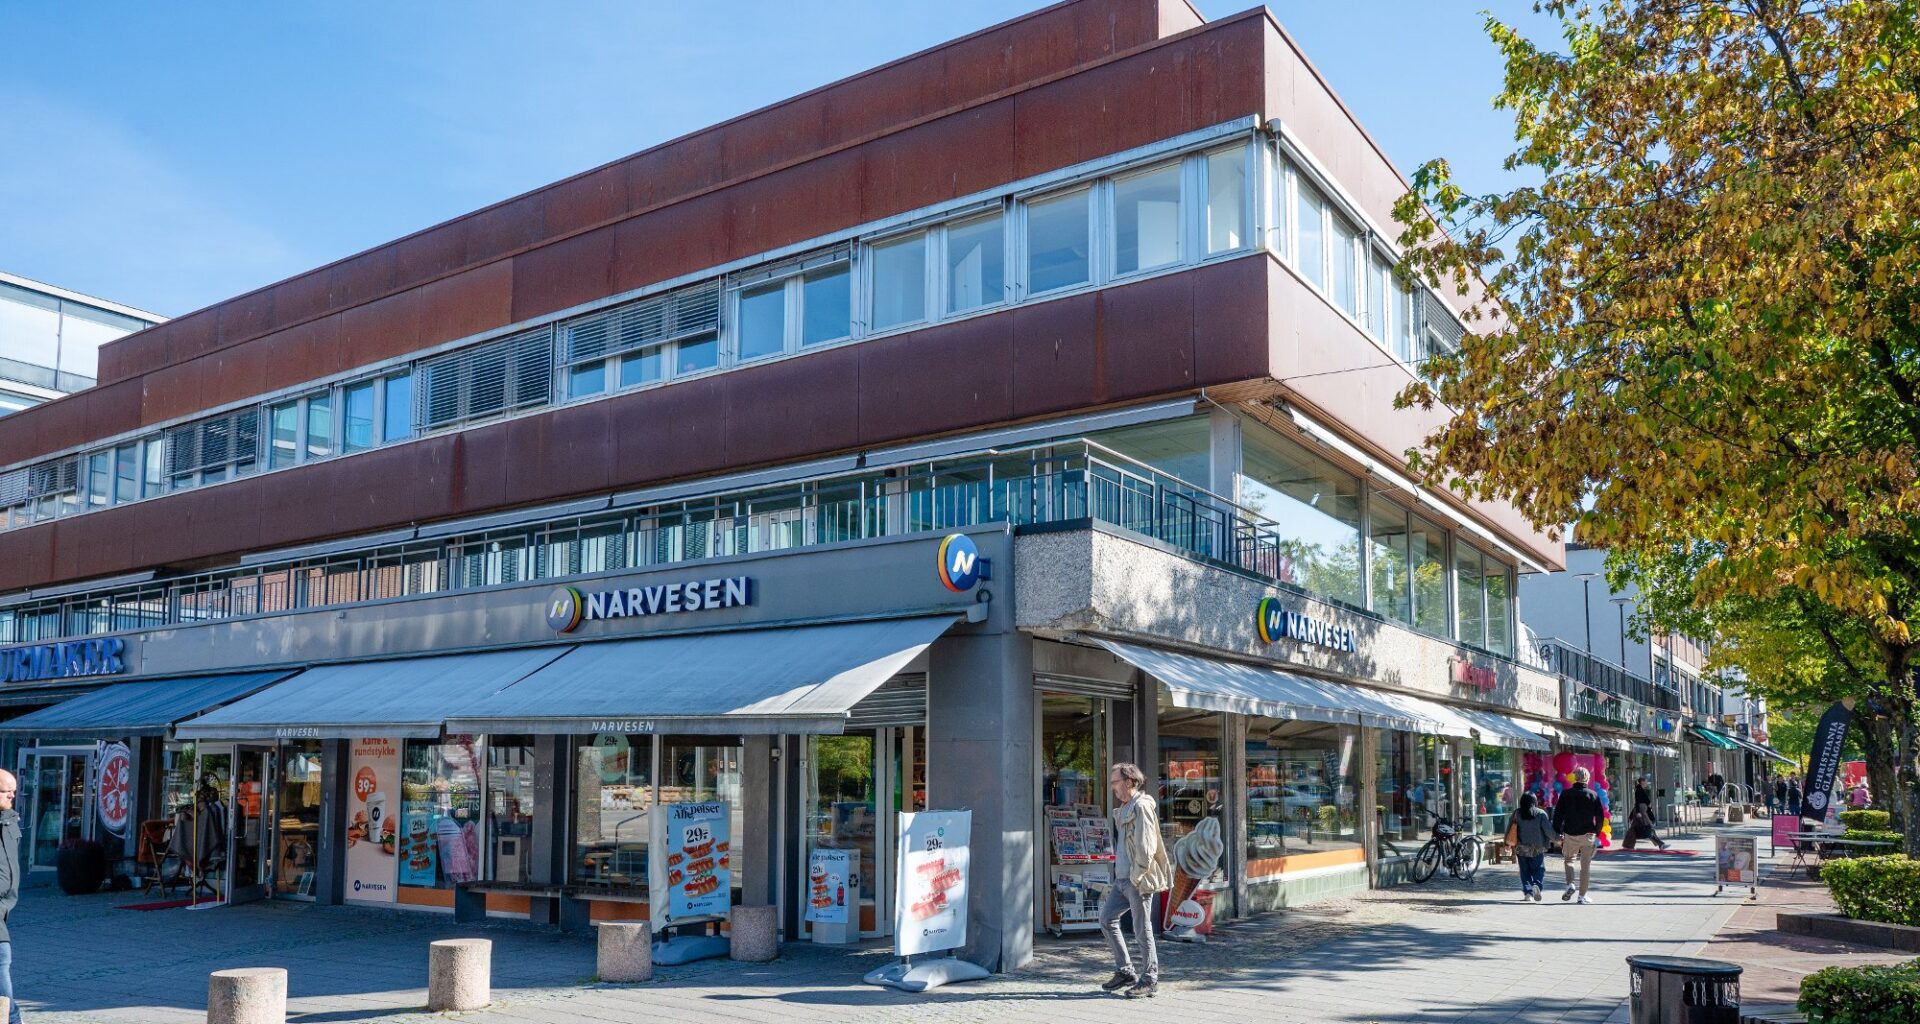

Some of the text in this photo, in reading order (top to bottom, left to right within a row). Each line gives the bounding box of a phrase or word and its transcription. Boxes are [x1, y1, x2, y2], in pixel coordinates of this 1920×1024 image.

[586, 575, 751, 620] NARVESEN
[1286, 611, 1357, 653] NARVESEN
[275, 727, 319, 737] NARVESEN
[591, 721, 655, 732] NARVESEN
[354, 746, 396, 759] rundstykke
[1815, 721, 1839, 790] CHRISTIANIA
[1822, 722, 1846, 792] GLASMAGASIN
